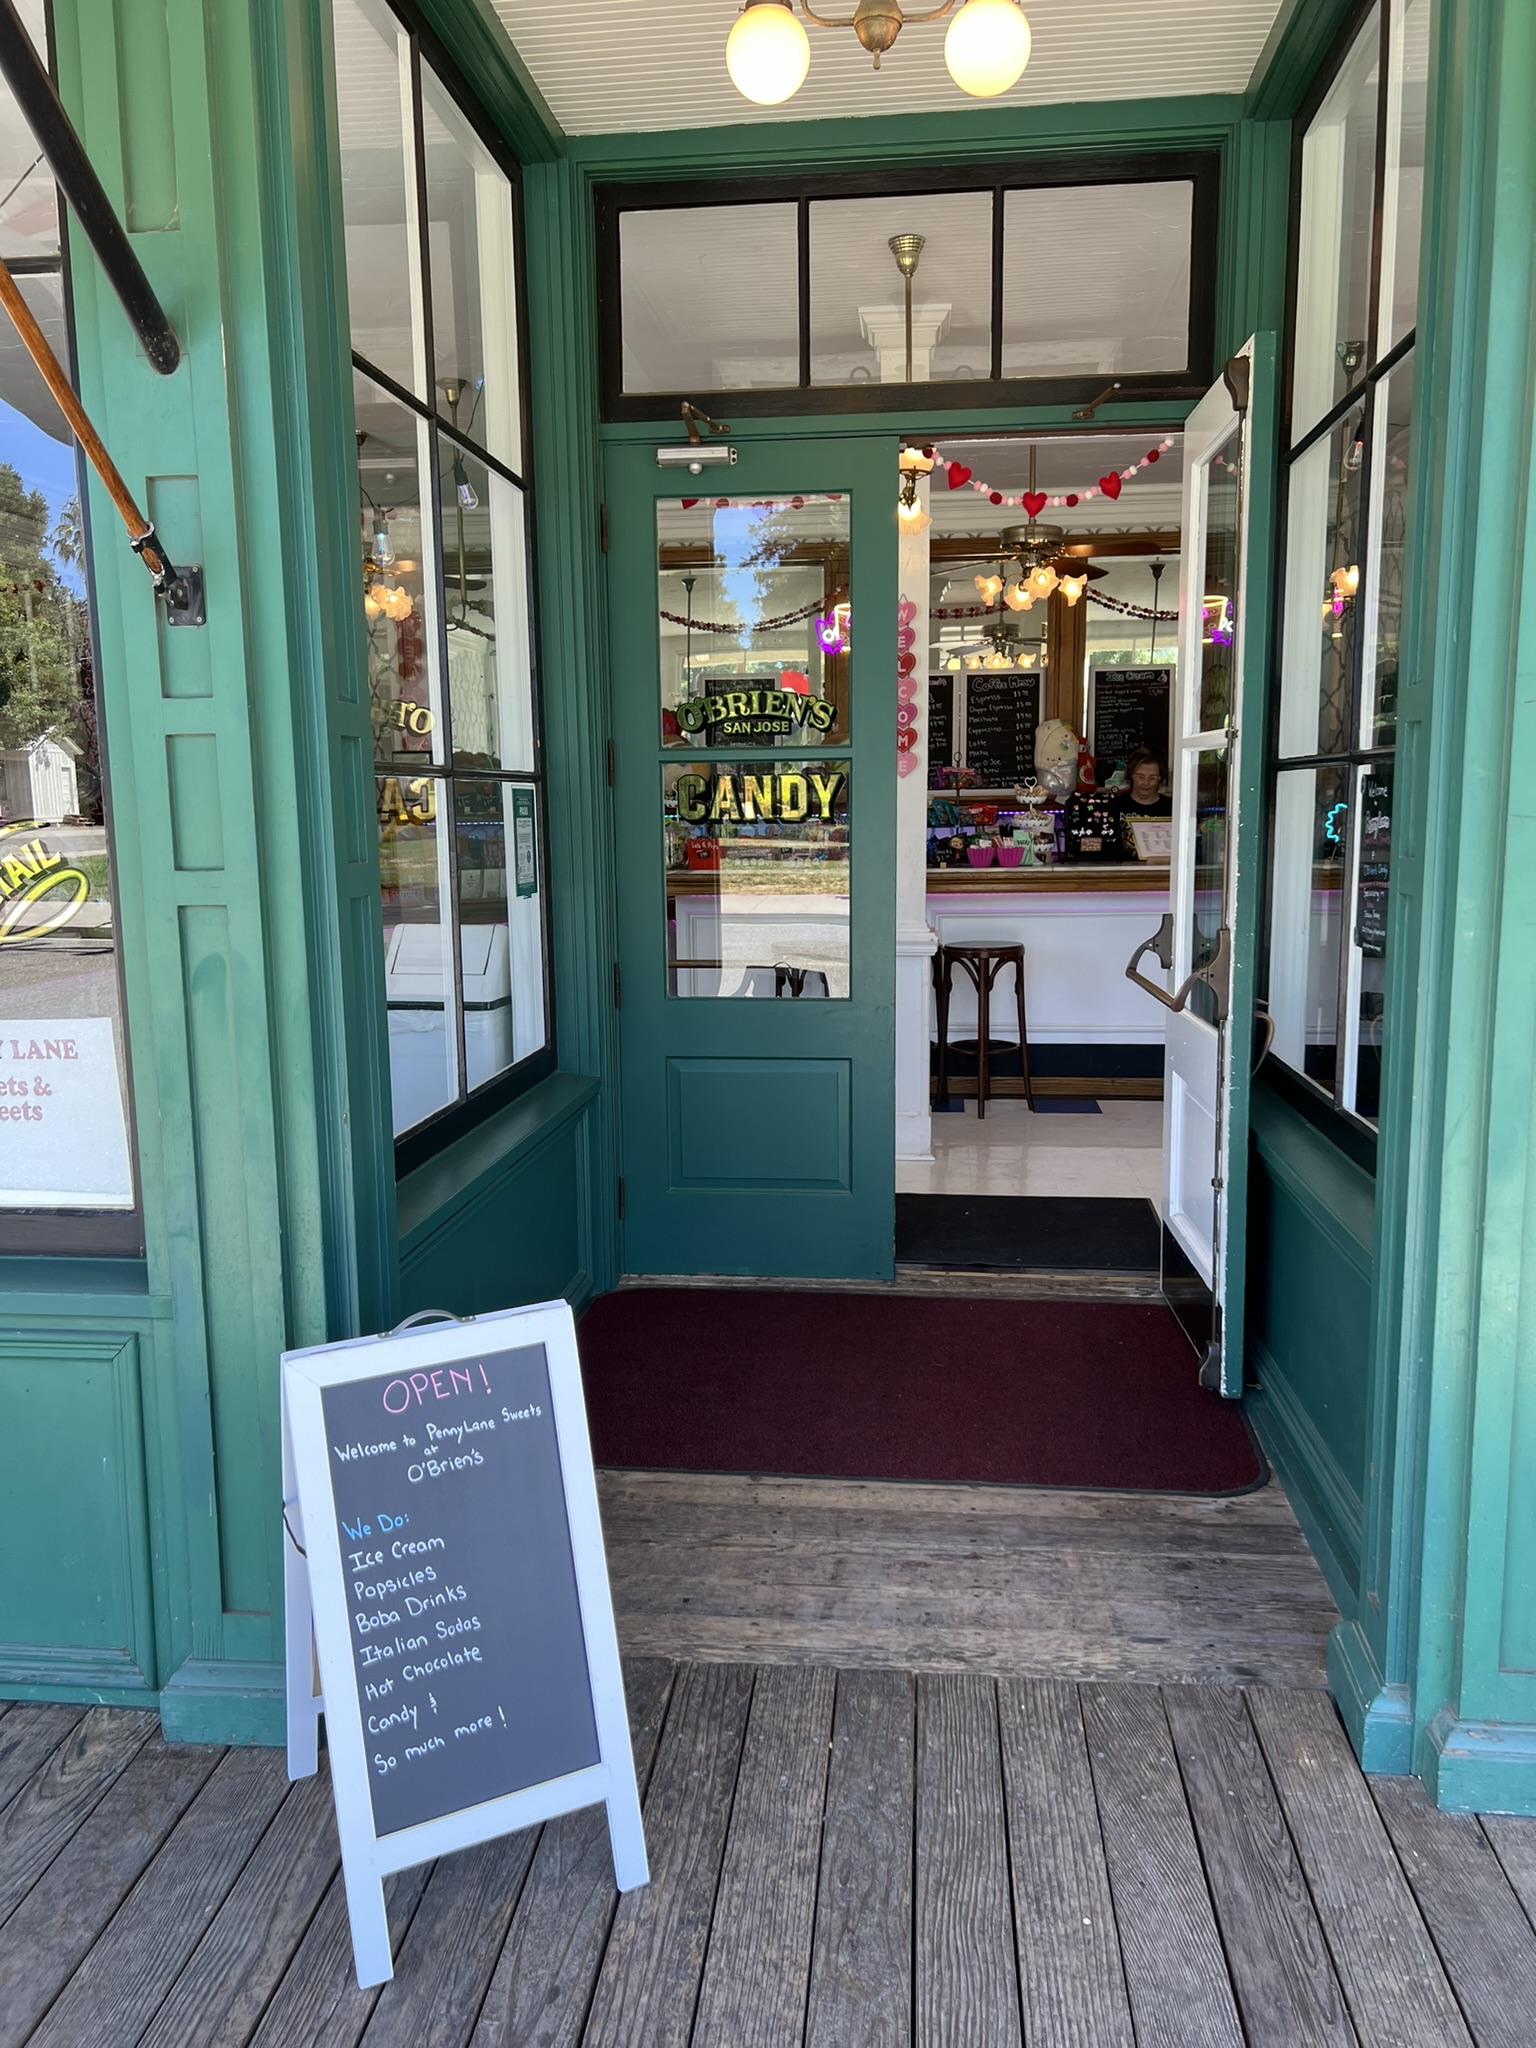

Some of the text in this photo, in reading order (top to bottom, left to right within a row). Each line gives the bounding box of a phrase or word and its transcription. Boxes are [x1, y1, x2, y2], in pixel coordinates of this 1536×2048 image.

[970, 694, 1001, 705] Espresso
[972, 676, 1035, 692] Coffee Menu
[676, 690, 836, 733] O'BRIEN'S
[723, 720, 790, 734] SAN JOSE
[968, 739, 987, 748] Latte
[677, 773, 846, 823] CANDY
[9, 1039, 79, 1060] LANE
[33, 1075, 53, 1096] &
[333, 1440, 398, 1463] Welcome
[402, 1434, 416, 1448] to
[501, 1404, 543, 1423] Sweets
[423, 1444, 439, 1457] at
[407, 1448, 484, 1483] O'Brien's
[341, 1513, 410, 1541] We Do:
[348, 1536, 445, 1573] Ice Cream
[354, 1565, 437, 1600] Popsicles
[354, 1584, 467, 1635] Boba Drinks
[359, 1615, 482, 1667] Italian Sodas
[364, 1646, 484, 1701] Hot Chocolate
[367, 1691, 439, 1735] Candy &
[374, 1753, 397, 1775] So
[405, 1735, 446, 1761] much
